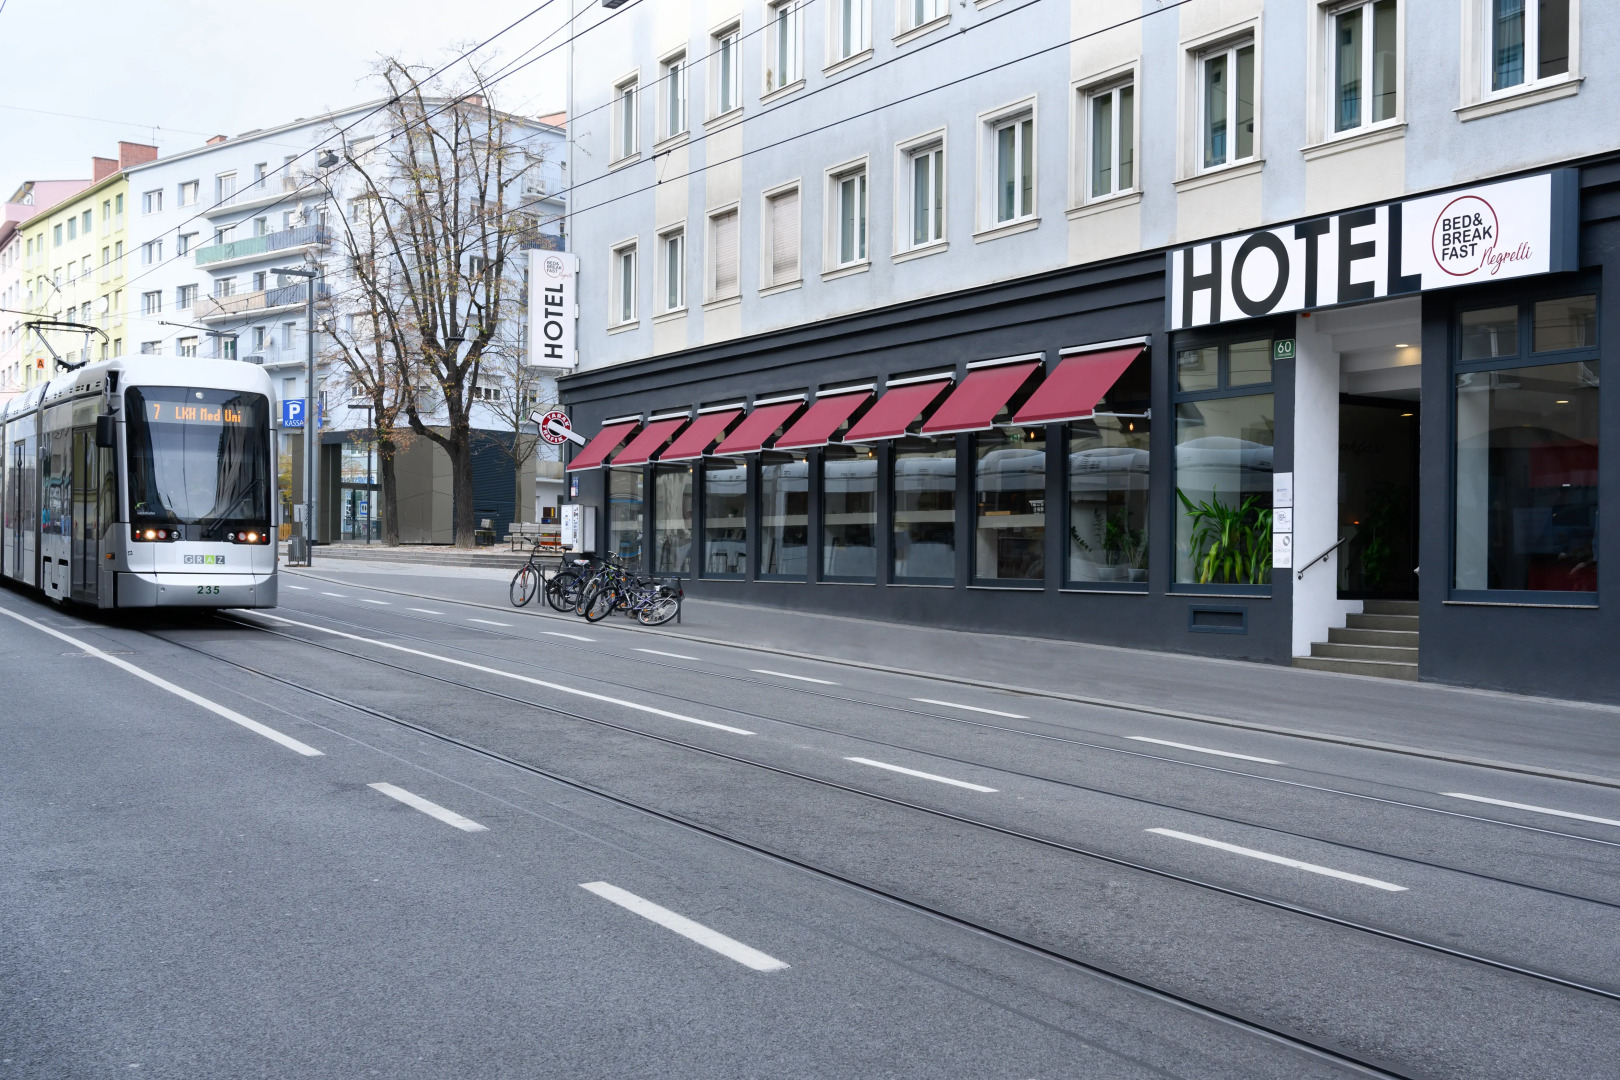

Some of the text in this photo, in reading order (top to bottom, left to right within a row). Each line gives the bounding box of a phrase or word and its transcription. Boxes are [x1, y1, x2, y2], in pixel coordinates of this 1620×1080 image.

[1442, 212, 1483, 232] BED&
[1442, 225, 1493, 247] BREAK
[1442, 243, 1478, 262] FAST
[1480, 241, 1533, 276] Negrelli
[1182, 202, 1422, 327] HOTEL
[544, 283, 564, 359] HOTEL
[1277, 341, 1292, 354] 60
[37, 359, 45, 368] A
[153, 403, 242, 423] 7 LKH Med Uni
[289, 403, 301, 419] P
[547, 413, 570, 427] TABAK
[542, 424, 563, 443] TRAFIK
[184, 555, 225, 564] GRAZ
[197, 585, 220, 595] 235
